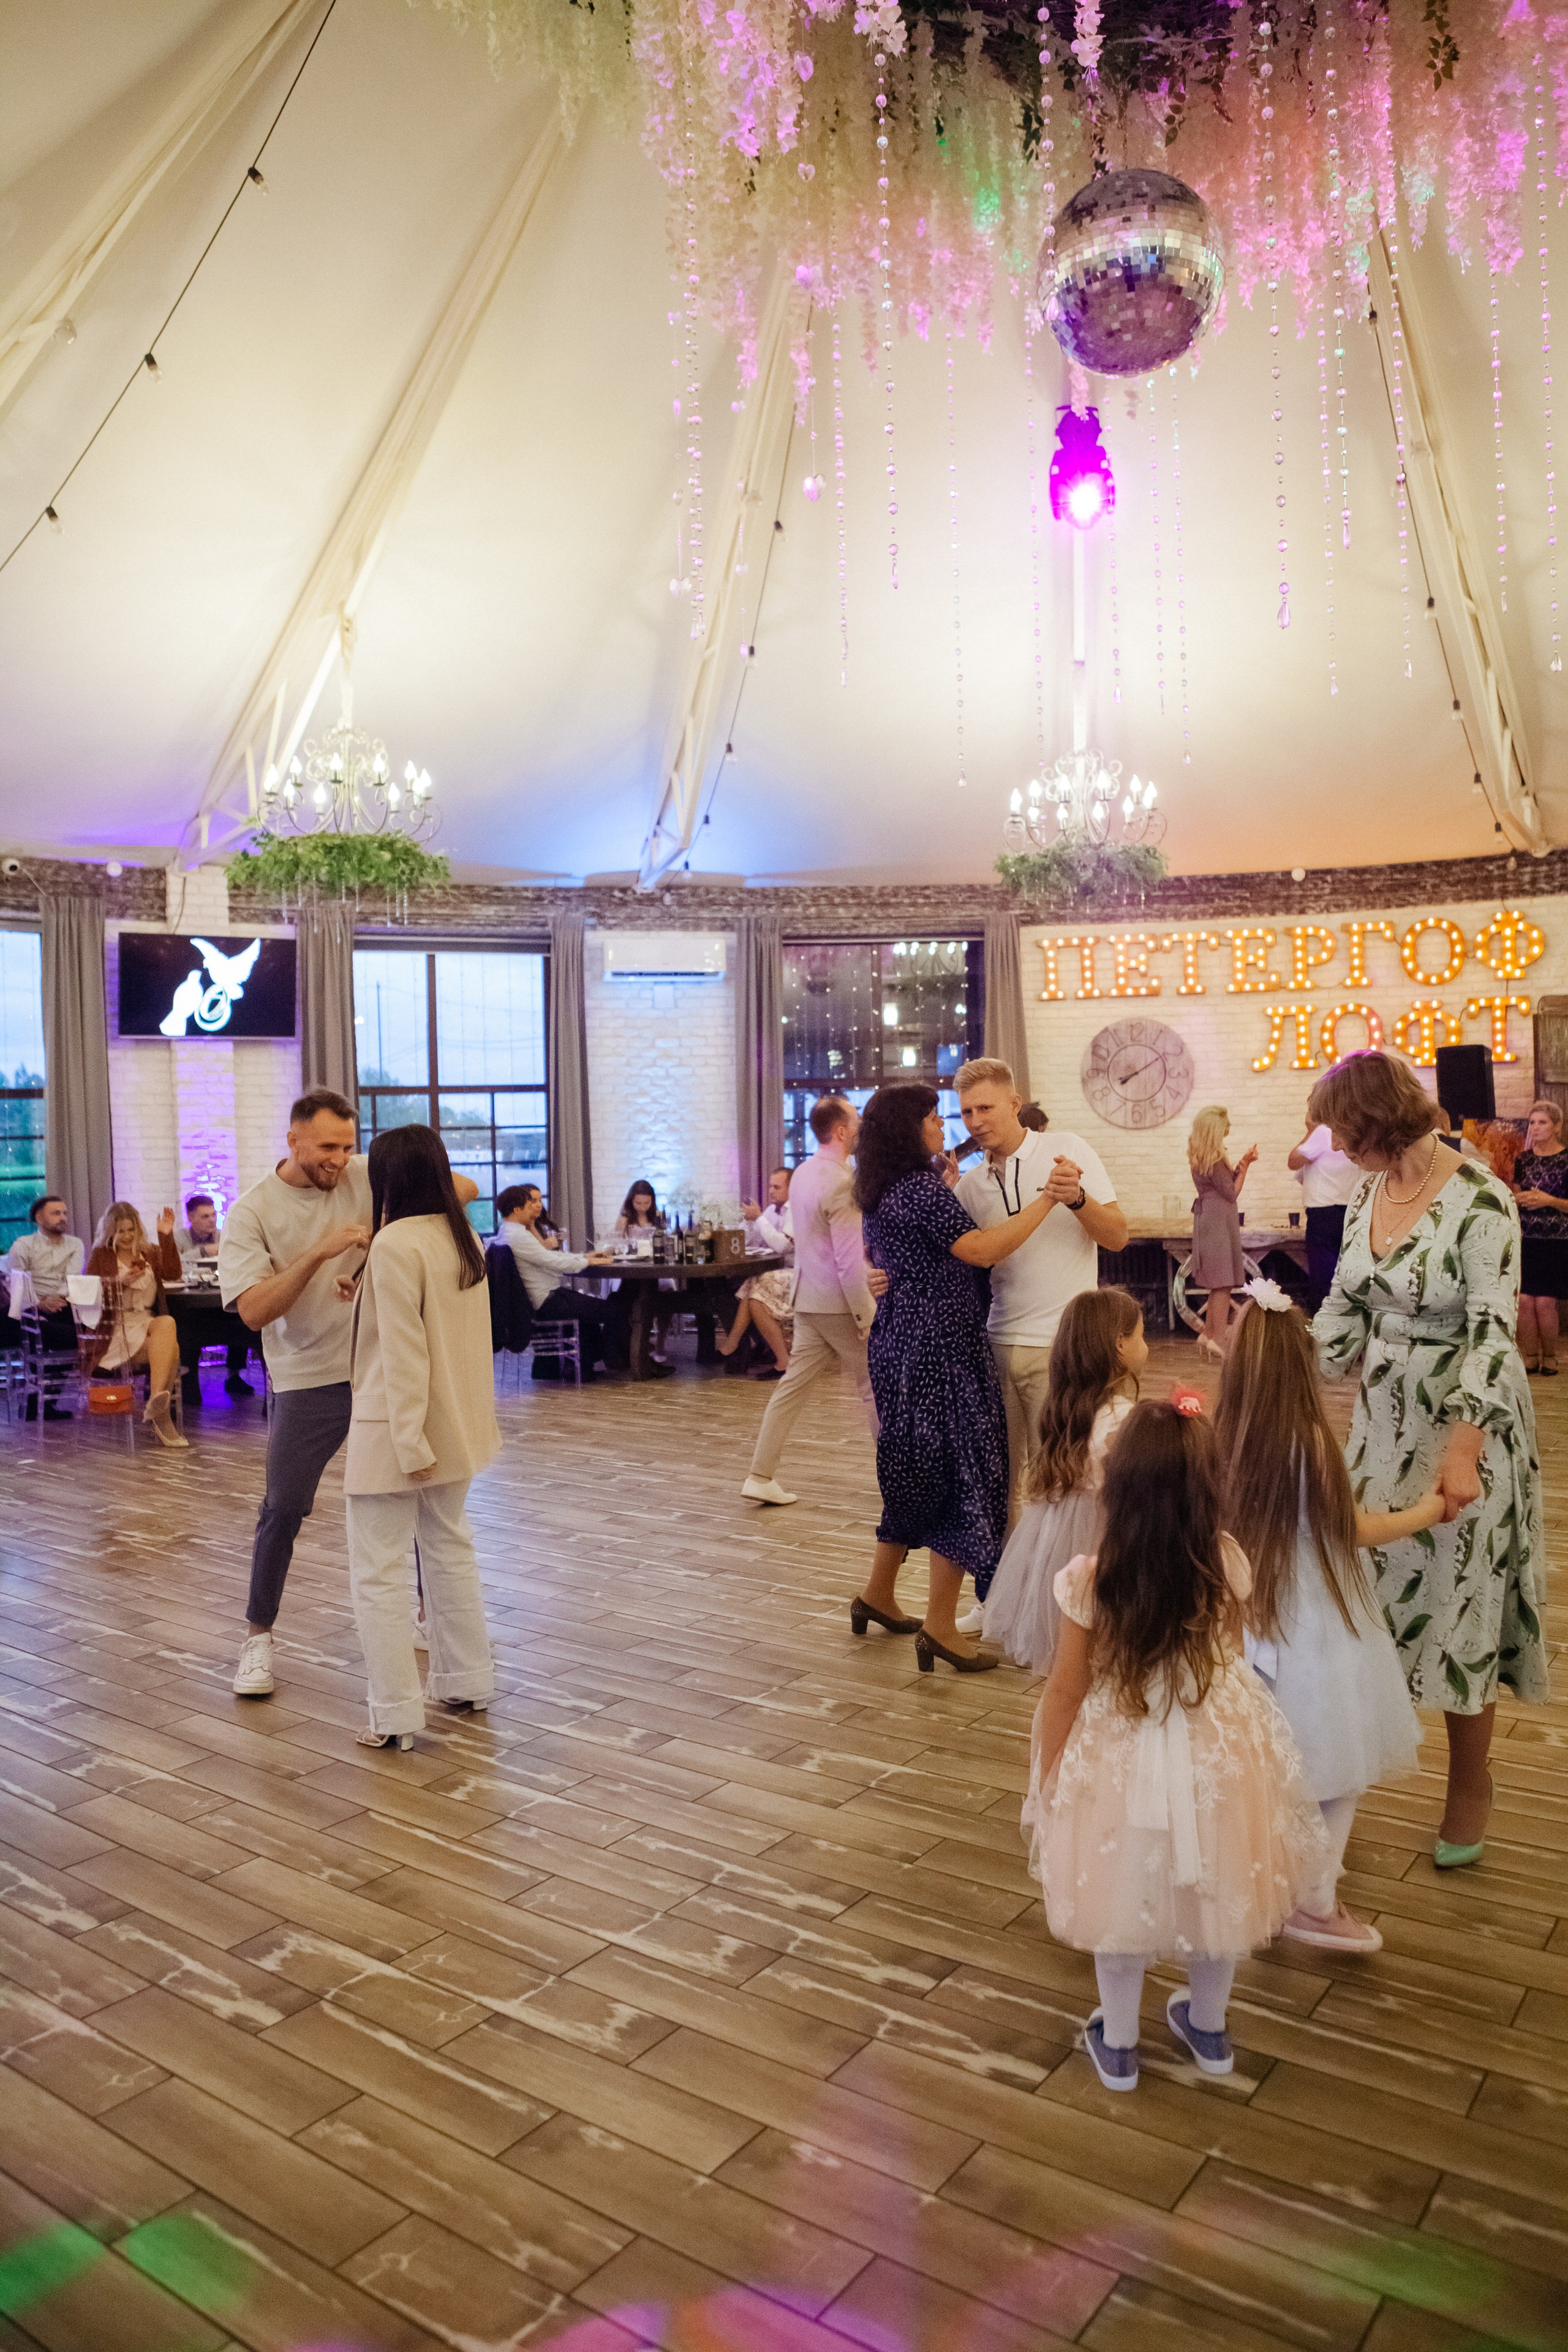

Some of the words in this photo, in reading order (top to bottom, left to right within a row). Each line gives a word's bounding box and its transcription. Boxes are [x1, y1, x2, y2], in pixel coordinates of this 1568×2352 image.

[1036, 910, 1544, 1000] ПЕТЕРГОФ
[1152, 1029, 1163, 1045] 1
[1252, 995, 1530, 1071] ЛОФТ
[1161, 1045, 1183, 1061] 2
[1086, 1068, 1106, 1079] 9
[1168, 1068, 1189, 1079] 3
[1093, 1086, 1110, 1101] 8
[1166, 1085, 1182, 1100] 4
[1110, 1099, 1127, 1115] 7
[1131, 1102, 1142, 1123] 6
[1150, 1099, 1166, 1117] 5
[731, 1237, 740, 1254] 8
